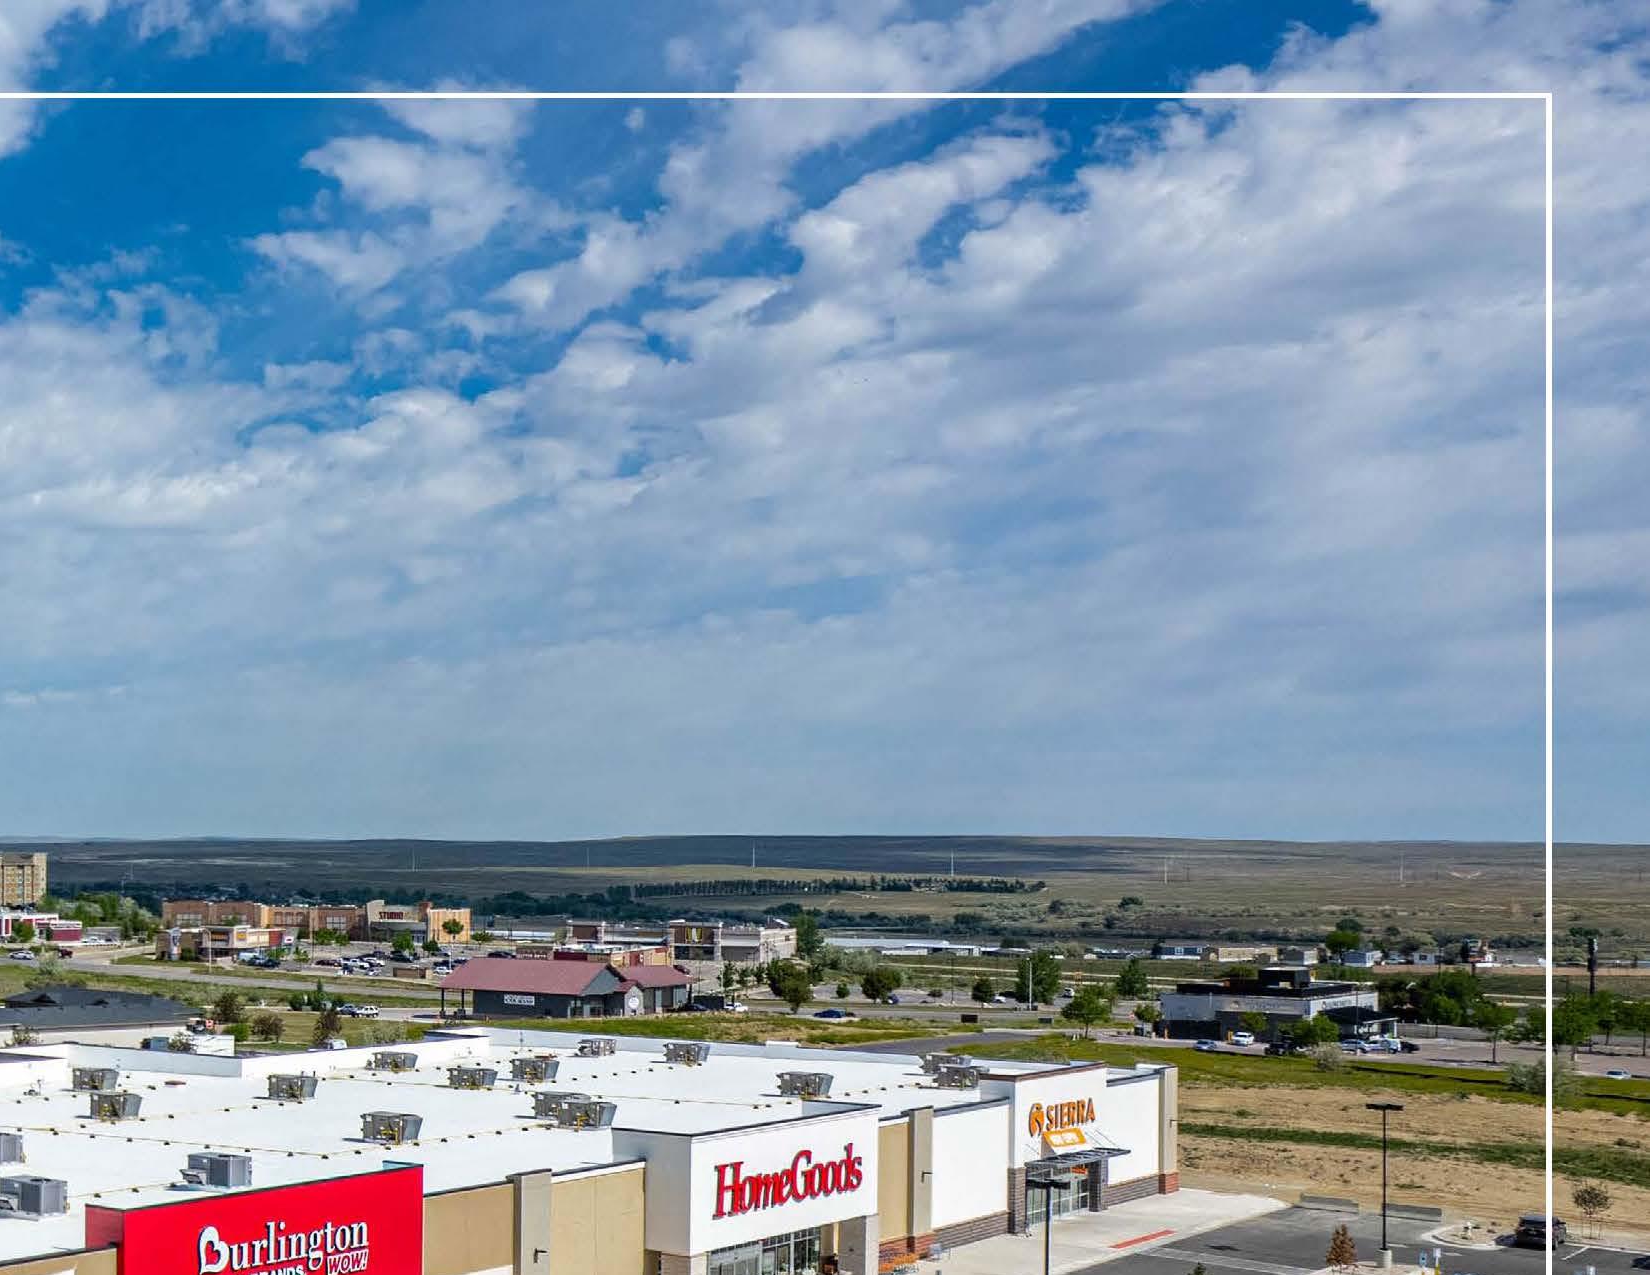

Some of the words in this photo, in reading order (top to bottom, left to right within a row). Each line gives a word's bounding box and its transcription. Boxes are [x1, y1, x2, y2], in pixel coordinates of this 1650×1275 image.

[1046, 1098, 1095, 1131] SIERRA
[712, 1143, 862, 1220] HomeGoods
[199, 1221, 369, 1275] Burlington
